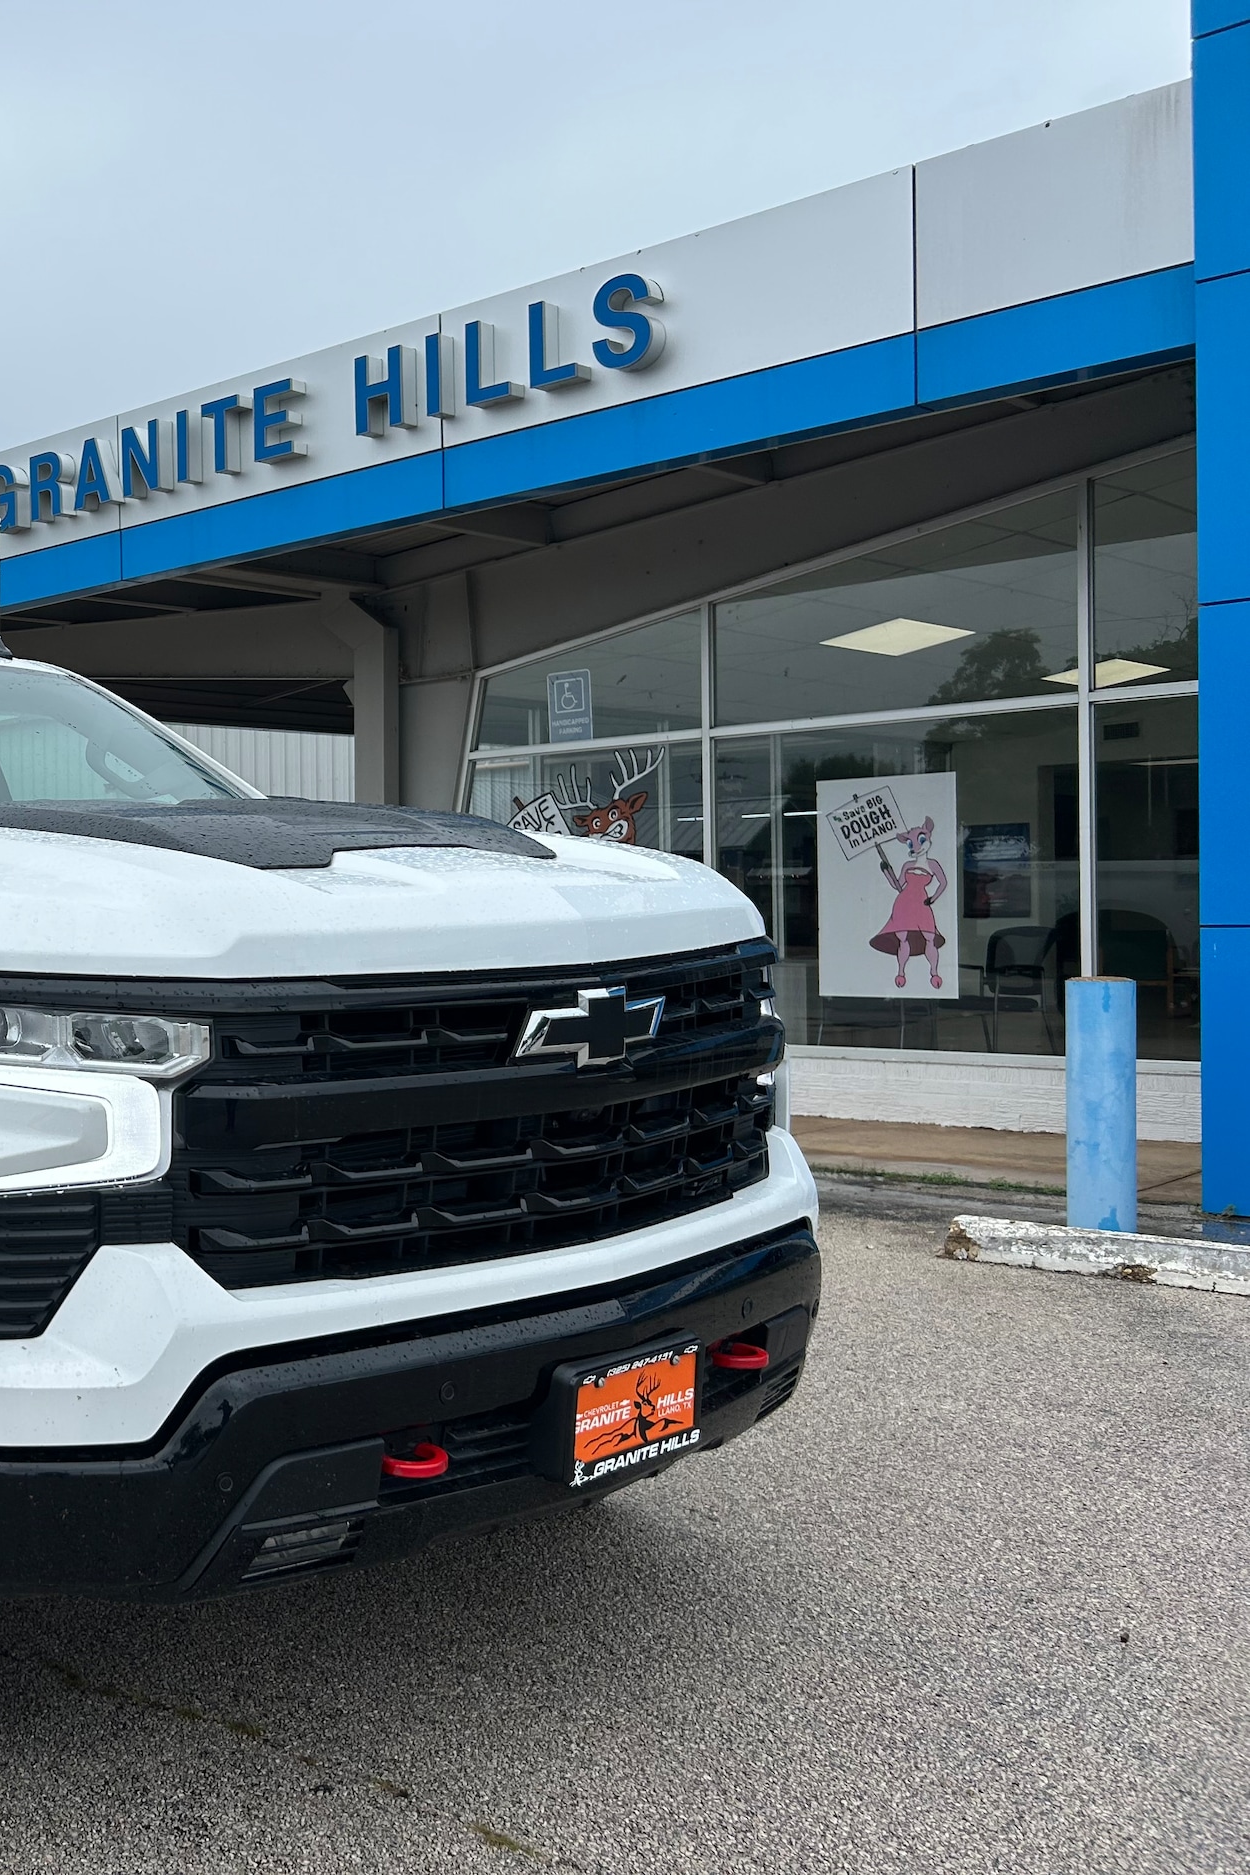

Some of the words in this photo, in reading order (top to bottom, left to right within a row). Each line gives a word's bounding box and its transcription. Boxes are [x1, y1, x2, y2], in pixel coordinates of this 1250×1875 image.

[354, 273, 660, 438] HILLS
[552, 717, 589, 727] HANDICAPPED
[559, 727, 582, 735] PARKING
[866, 795, 883, 809] BIG
[513, 799, 556, 831] SAVE
[840, 804, 892, 840] DOUGH
[859, 819, 897, 844] LLANO!
[607, 1363, 630, 1377] (325)
[583, 1401, 620, 1417] CHEVROLET
[656, 1387, 695, 1409] HILLS
[575, 1406, 632, 1435] GRANITE
[657, 1403, 682, 1418] LLANO,
[683, 1401, 692, 1409] TX
[593, 1442, 661, 1477] GRANITE
[660, 1428, 701, 1455] HILLS
